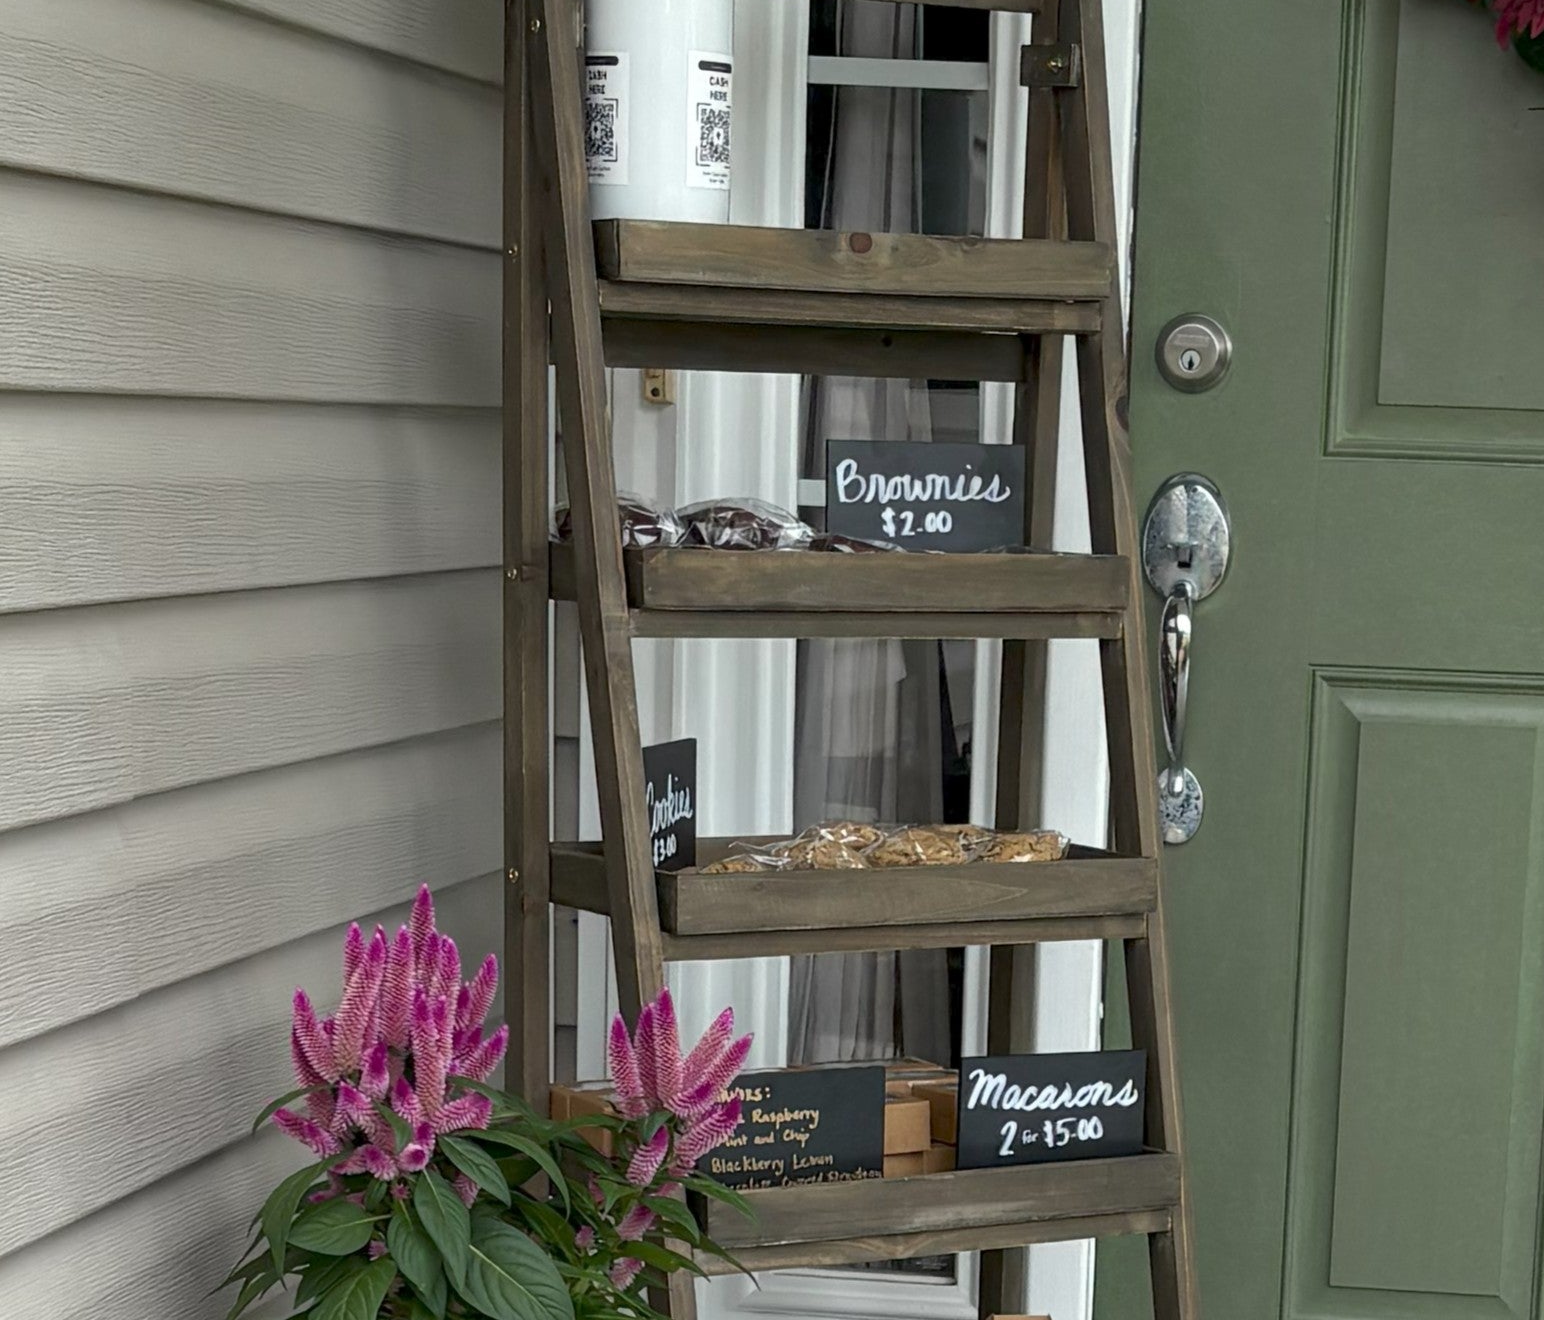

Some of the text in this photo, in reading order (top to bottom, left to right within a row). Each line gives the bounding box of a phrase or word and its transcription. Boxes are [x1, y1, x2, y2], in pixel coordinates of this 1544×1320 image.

[835, 458, 1011, 504] Brownies
[967, 1069, 1138, 1111] Macarons
[752, 1108, 819, 1130] Raspberry
[999, 1121, 1018, 1156] 2
[711, 1153, 834, 1176] Blackberry Lemon
